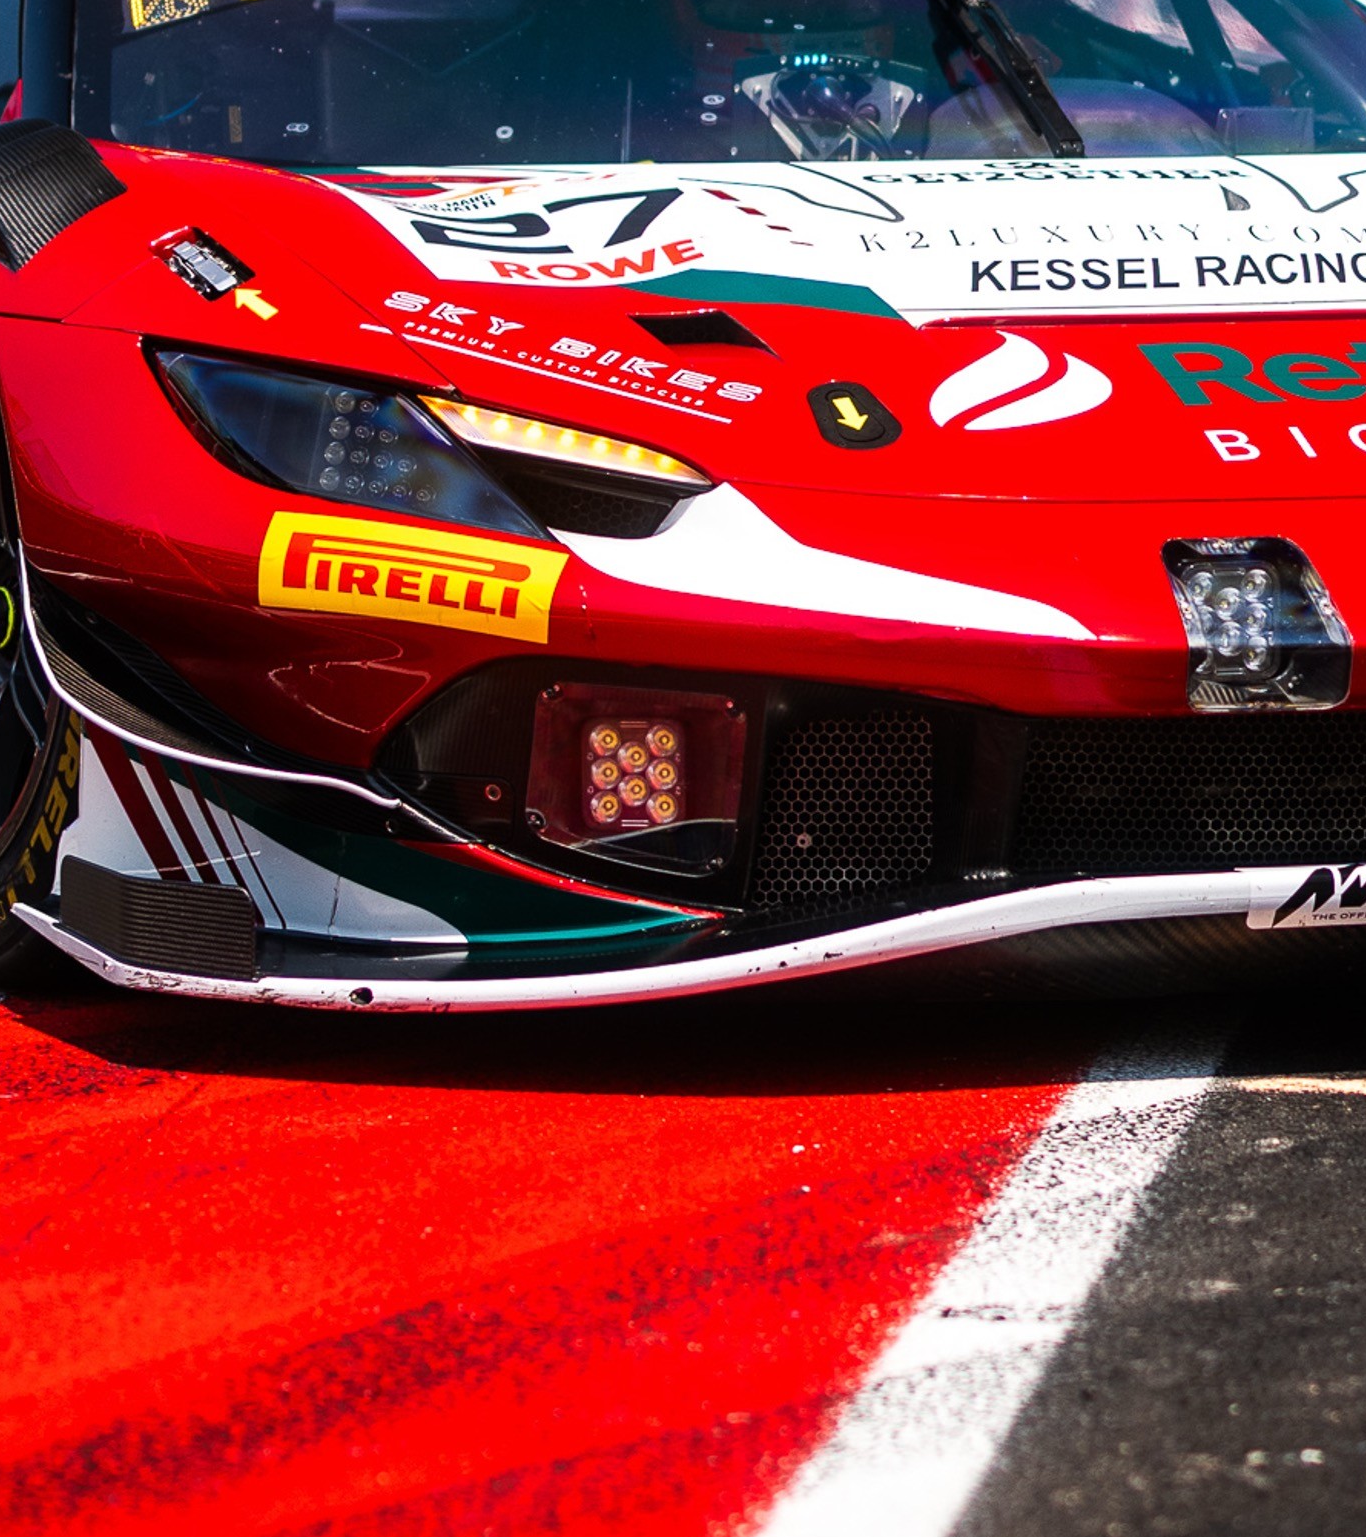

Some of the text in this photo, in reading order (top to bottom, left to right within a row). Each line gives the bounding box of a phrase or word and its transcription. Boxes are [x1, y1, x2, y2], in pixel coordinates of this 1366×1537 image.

[396, 187, 684, 254] 27
[489, 239, 705, 281] ROWE
[970, 257, 1180, 292] KESSEL
[384, 291, 764, 403] SKY BIKES
[404, 321, 705, 408] PREMIUM CUSTOM BICYCLES
[282, 531, 532, 619] PIRELLI
[1312, 912, 1335, 921] THE
